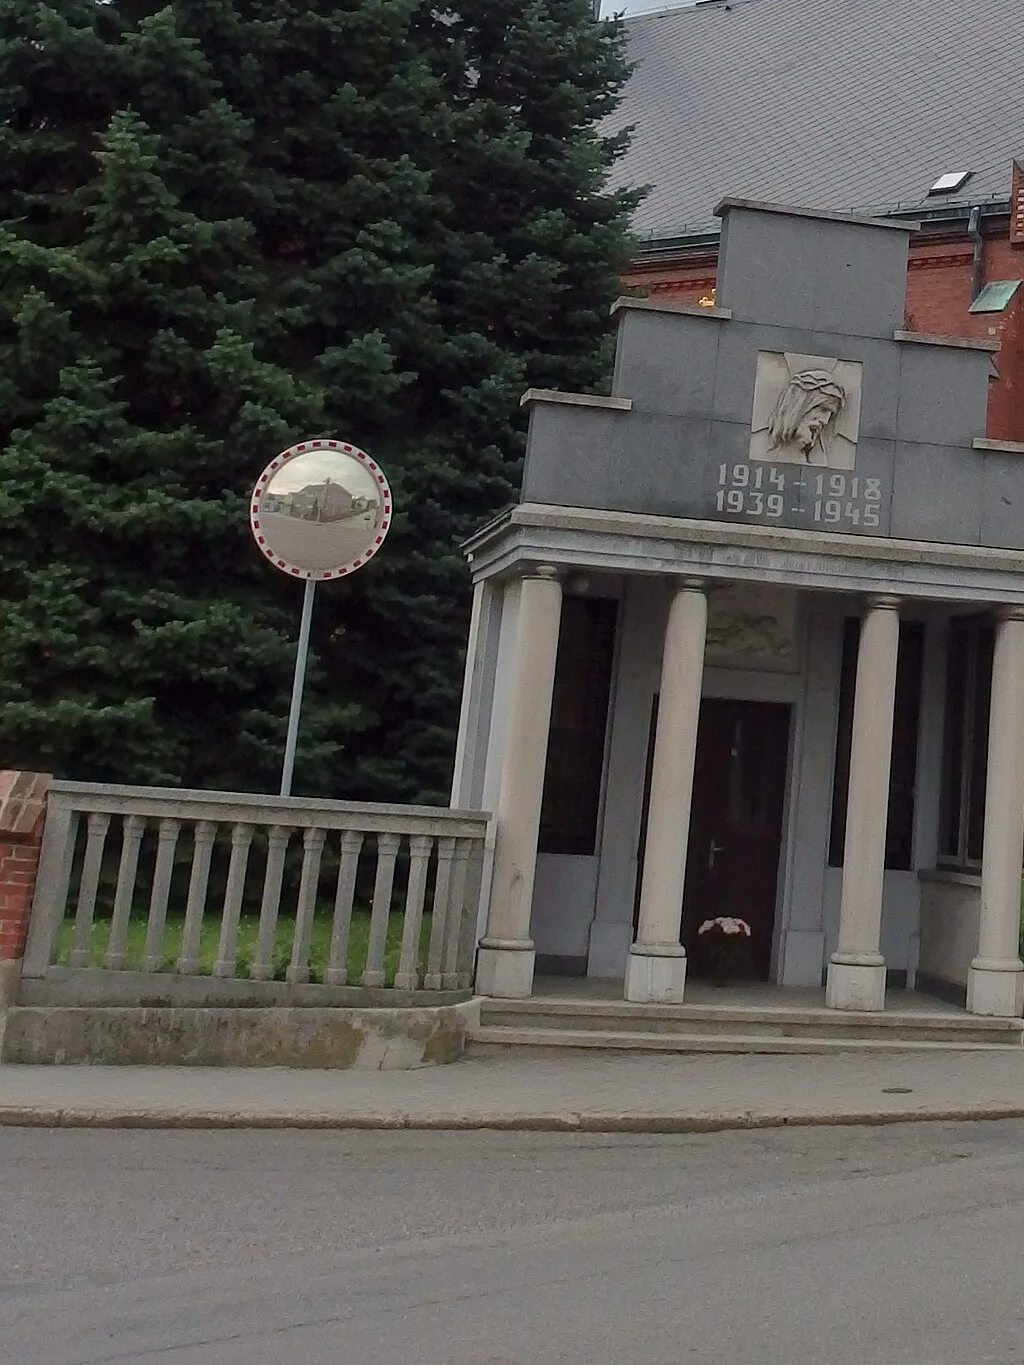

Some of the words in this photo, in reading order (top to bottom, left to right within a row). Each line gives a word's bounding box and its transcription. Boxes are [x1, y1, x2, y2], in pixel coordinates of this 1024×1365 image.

[718, 463, 786, 491] 1914
[815, 473, 882, 500] 1918
[715, 489, 784, 518] 1939
[814, 499, 880, 527] 1945
